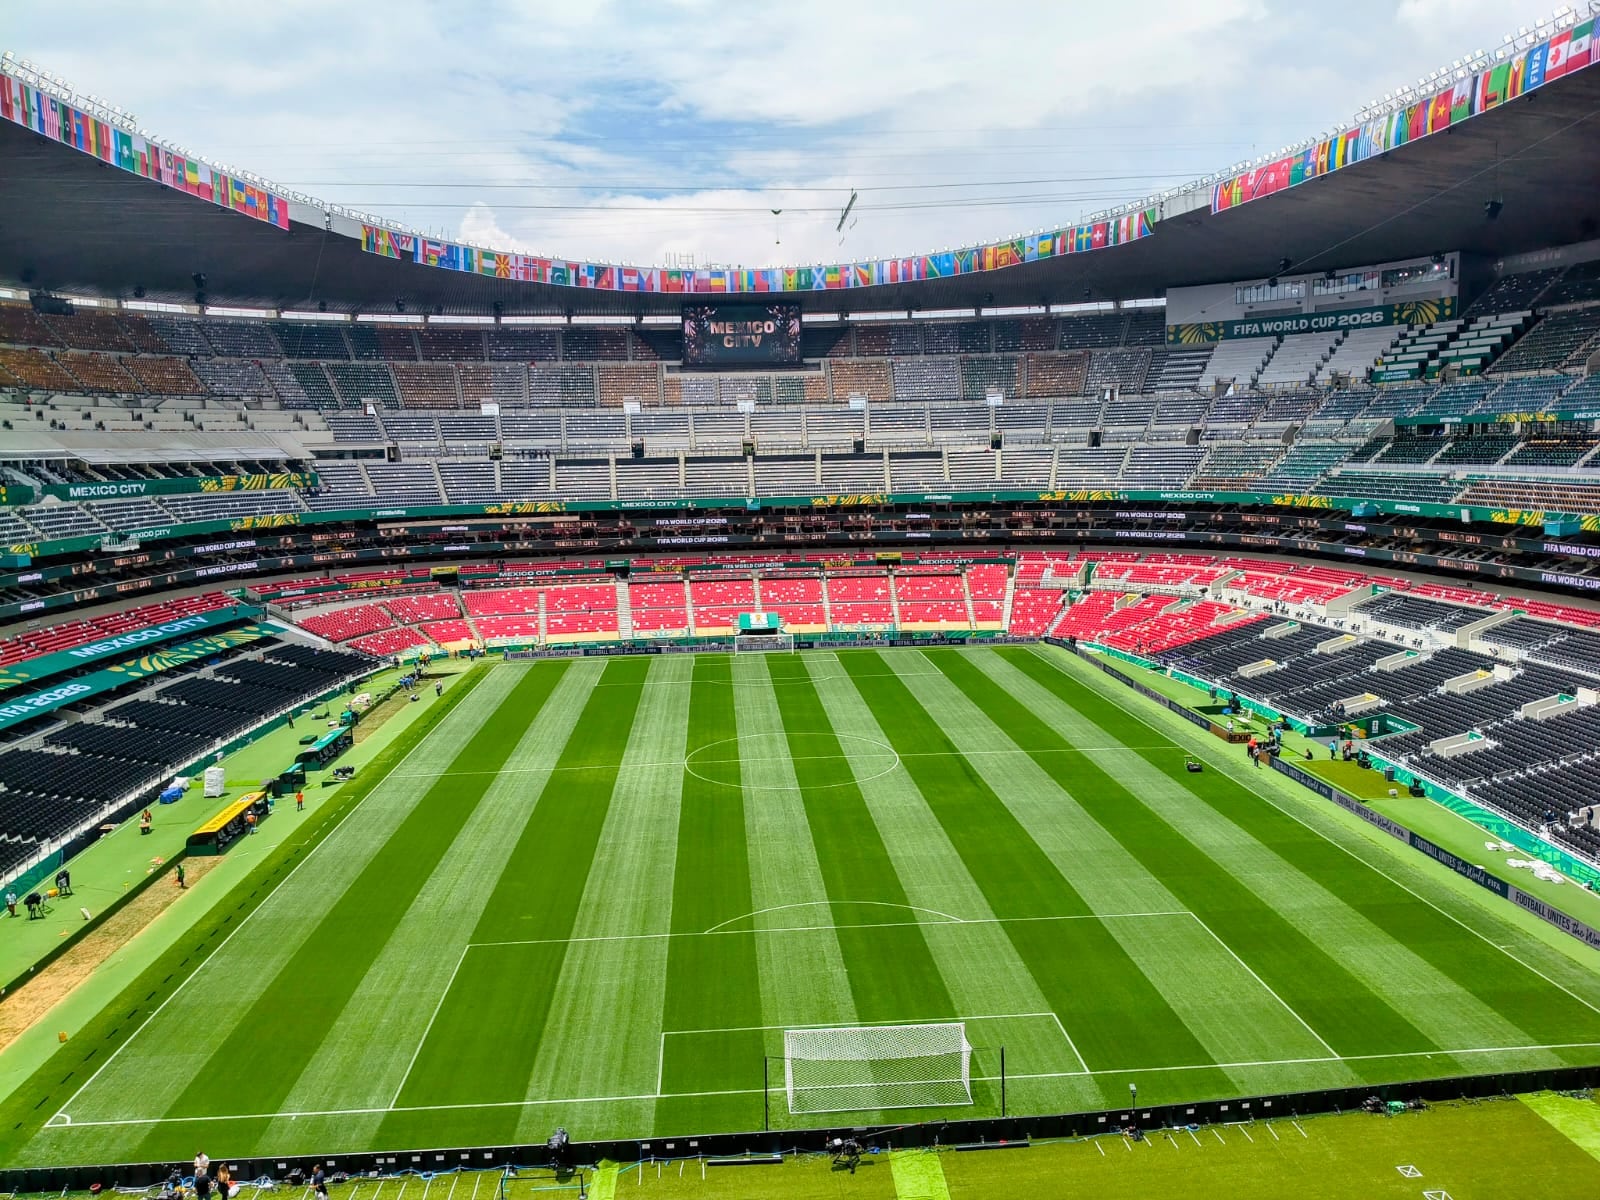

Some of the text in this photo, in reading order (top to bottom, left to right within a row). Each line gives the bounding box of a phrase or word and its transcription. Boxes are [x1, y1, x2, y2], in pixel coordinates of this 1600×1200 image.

[1530, 49, 1543, 84] FIFA
[710, 321, 775, 334] MEXICO
[1234, 311, 1384, 336] FIFA WORLD CUP 2026
[723, 335, 762, 348] CITY
[69, 483, 146, 498] MEXICO CITY
[1544, 544, 1559, 552] FIFA
[1560, 545, 1586, 555] WORLD
[1542, 574, 1557, 582] FIFA
[1558, 575, 1585, 586] WORLD
[69, 616, 208, 657] MEXICO CITY
[0, 684, 92, 721] IFA 2026
[1415, 837, 1438, 858] FOOTBALL
[1438, 850, 1457, 867] UNITES
[1487, 879, 1501, 891] FIFA
[1516, 892, 1546, 917] FOOTBALL
[1548, 908, 1570, 930] UNITES
